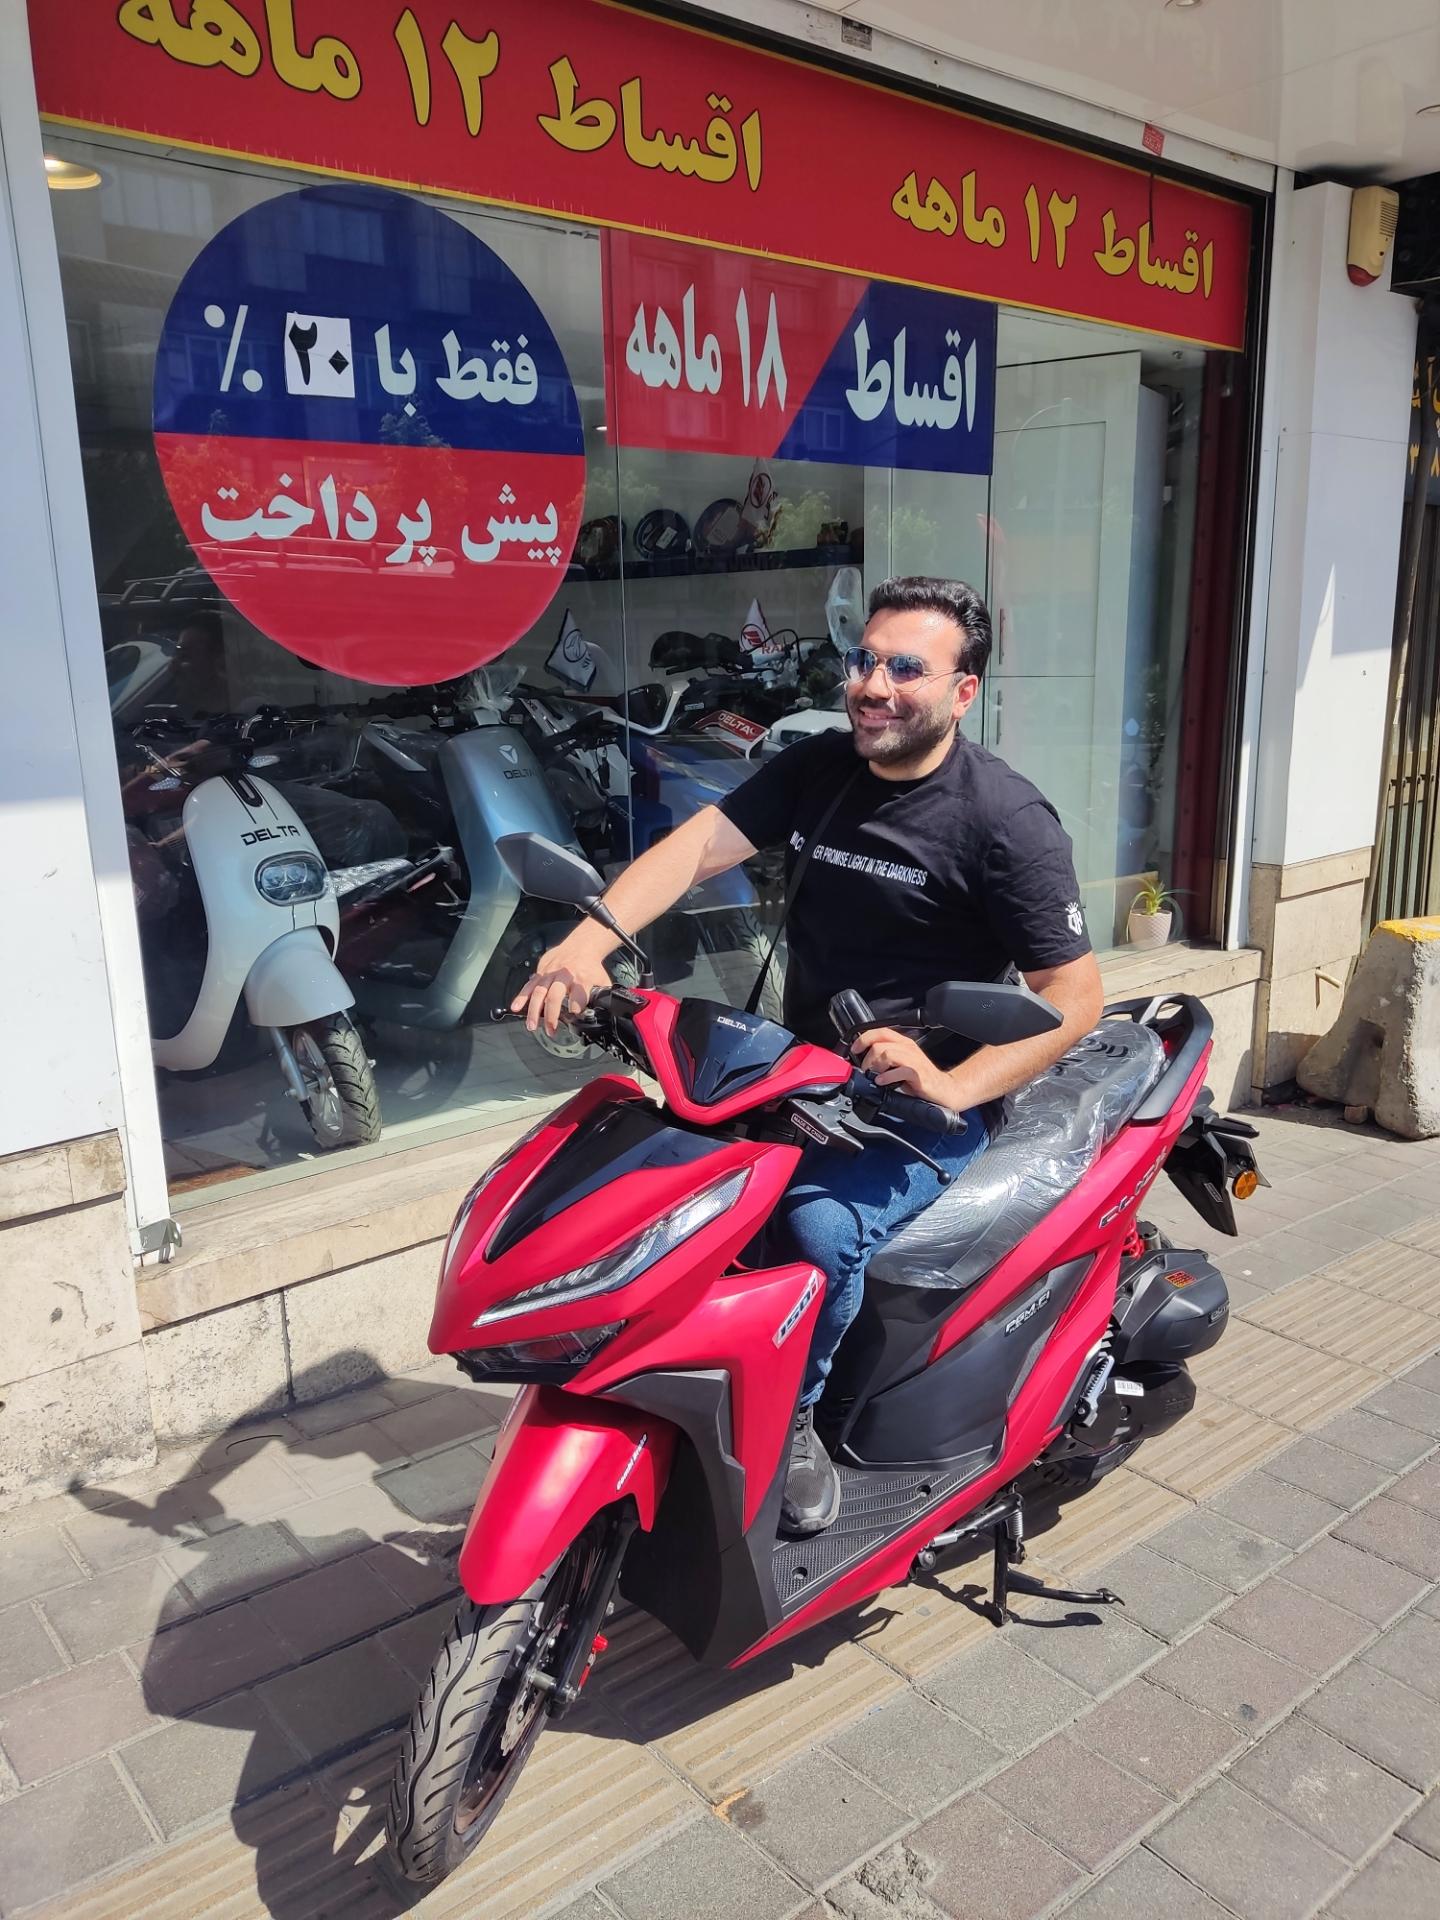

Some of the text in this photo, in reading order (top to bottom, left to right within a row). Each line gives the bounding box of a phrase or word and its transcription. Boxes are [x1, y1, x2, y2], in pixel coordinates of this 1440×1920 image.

[393, 8, 500, 137] ۱۲
[537, 57, 763, 192] اقساط
[892, 170, 1214, 299] اقساط ۱۲ ماهه
[288, 319, 349, 387] ۲۰
[374, 323, 417, 417] با
[436, 329, 539, 405] فقط
[625, 283, 978, 433] اقساط ۱۸ ماهه
[461, 483, 562, 567] پیش
[718, 712, 750, 735] DELTA
[240, 824, 301, 847] DELTA
[821, 846, 850, 868] PROMISE
[847, 853, 869, 872] LIGHT
[864, 858, 876, 874] IN
[873, 859, 890, 877] THE
[886, 862, 928, 887] DARKNESS
[717, 1015, 747, 1032] DELTA
[793, 1115, 807, 1128] MADE
[810, 1129, 826, 1142] CHINA
